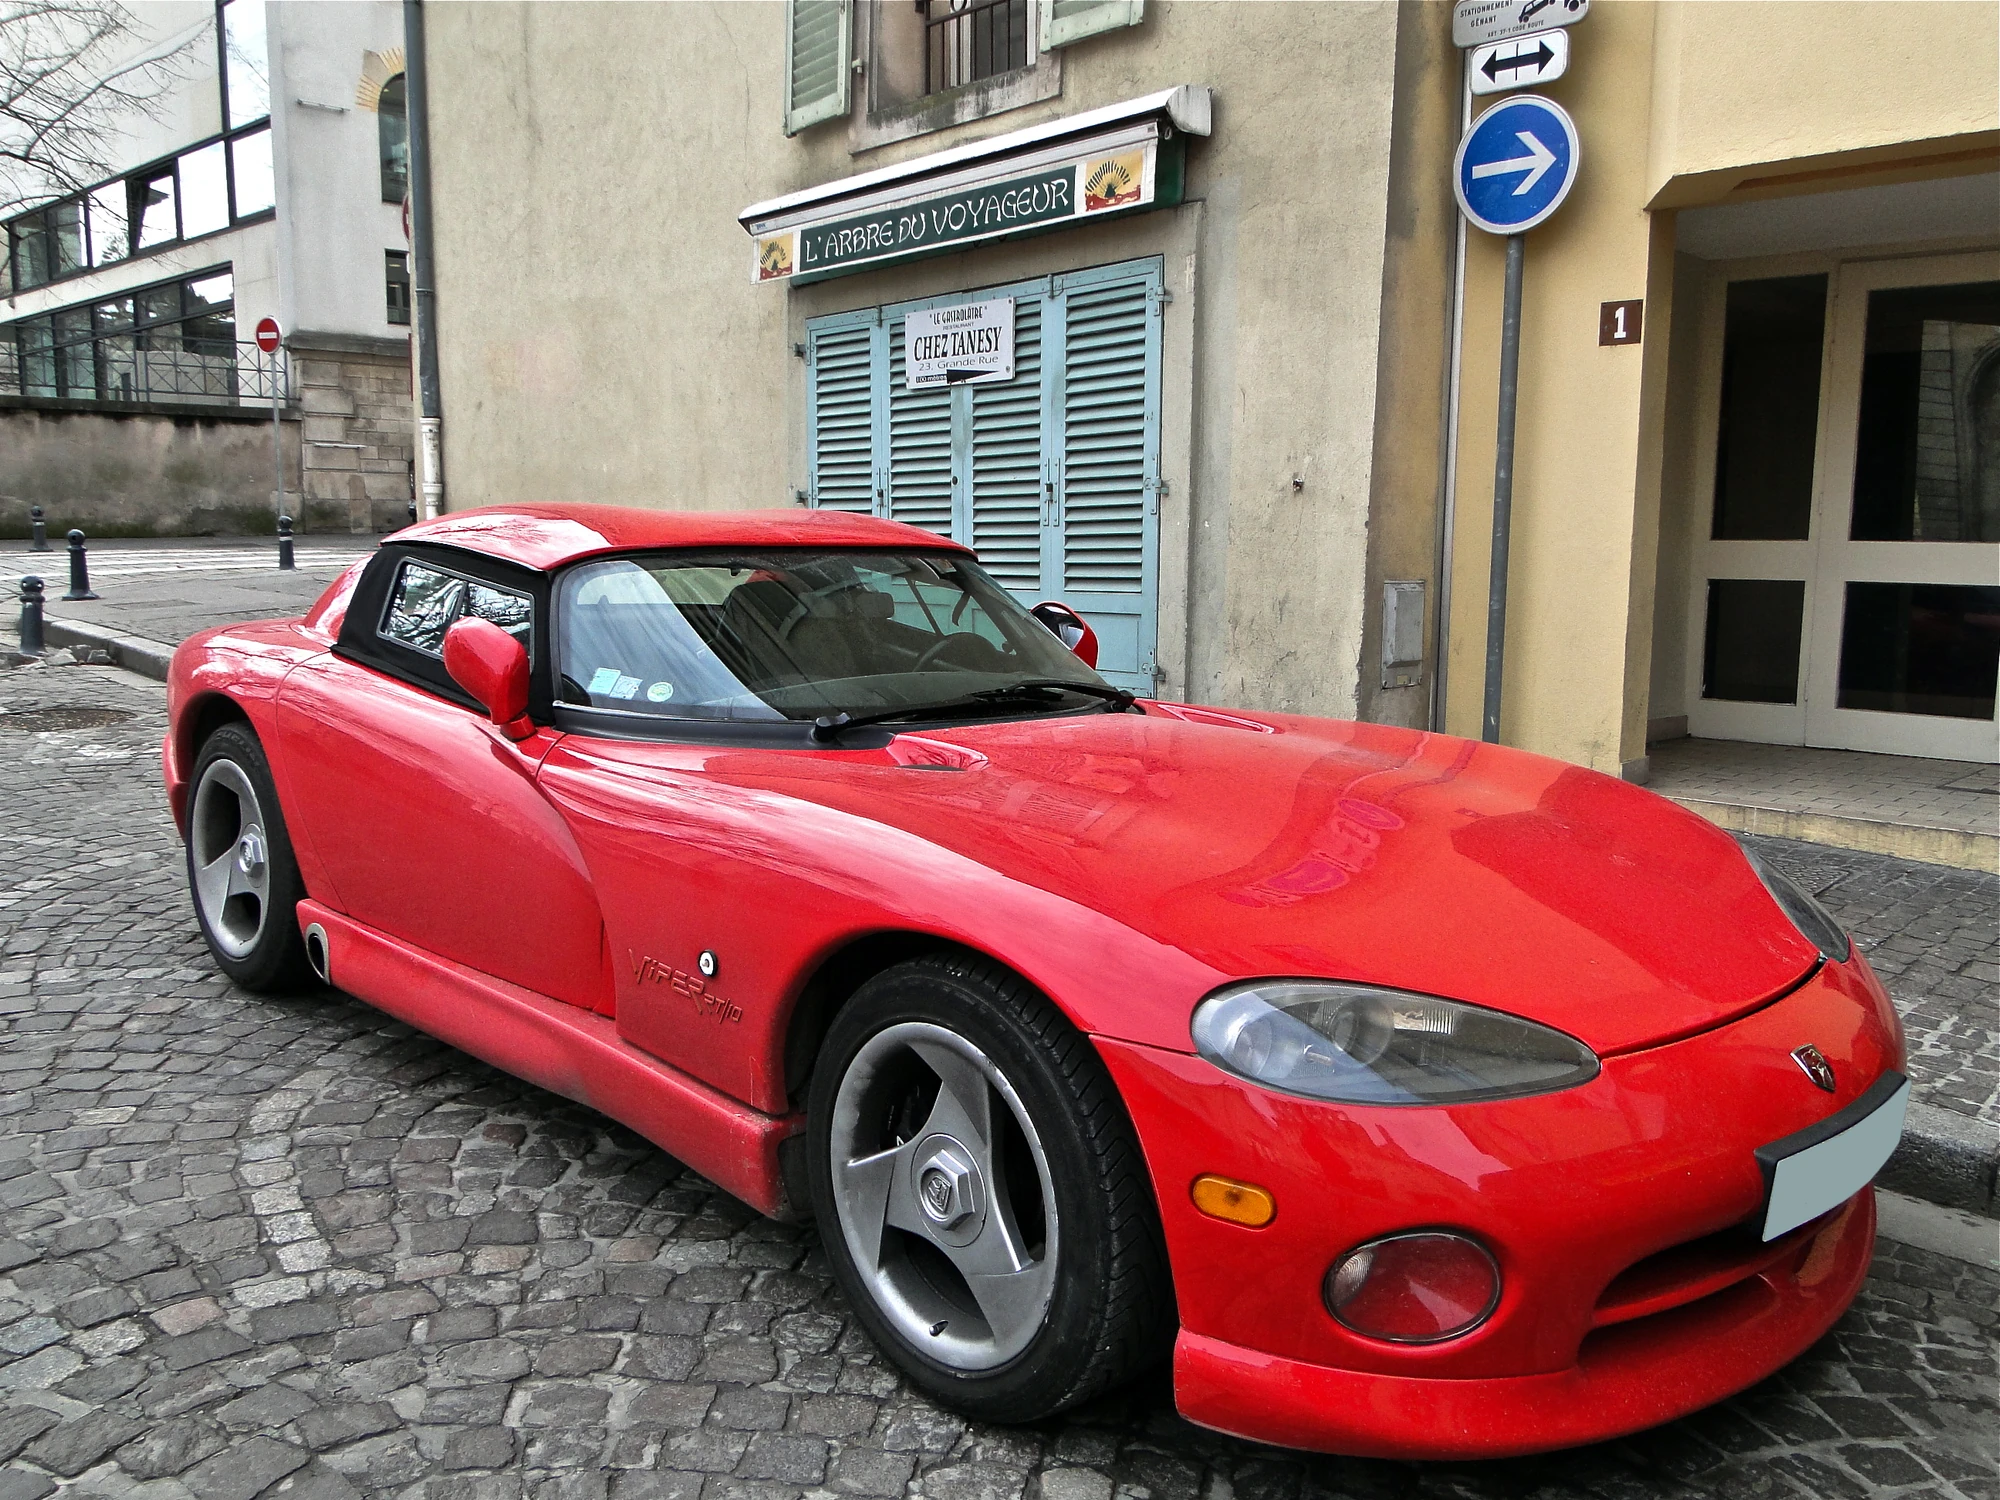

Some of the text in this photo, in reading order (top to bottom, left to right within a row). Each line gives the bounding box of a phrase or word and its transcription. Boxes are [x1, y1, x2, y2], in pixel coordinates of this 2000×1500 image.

[1460, 0, 1513, 18] STATIONNEMENT
[1470, 15, 1497, 28] GÊNANT
[1512, 24, 1525, 32] CODE
[1527, 20, 1545, 28] ROUTE
[804, 178, 1070, 263] L'ARBRE DU VOYAGEUR
[942, 322, 974, 331] RESTAURANT
[1613, 306, 1627, 339] 1
[914, 326, 1002, 361] CHEZ TANESY
[937, 358, 976, 369] Grande
[978, 355, 999, 365] Rue
[703, 993, 743, 1024] RT/10
